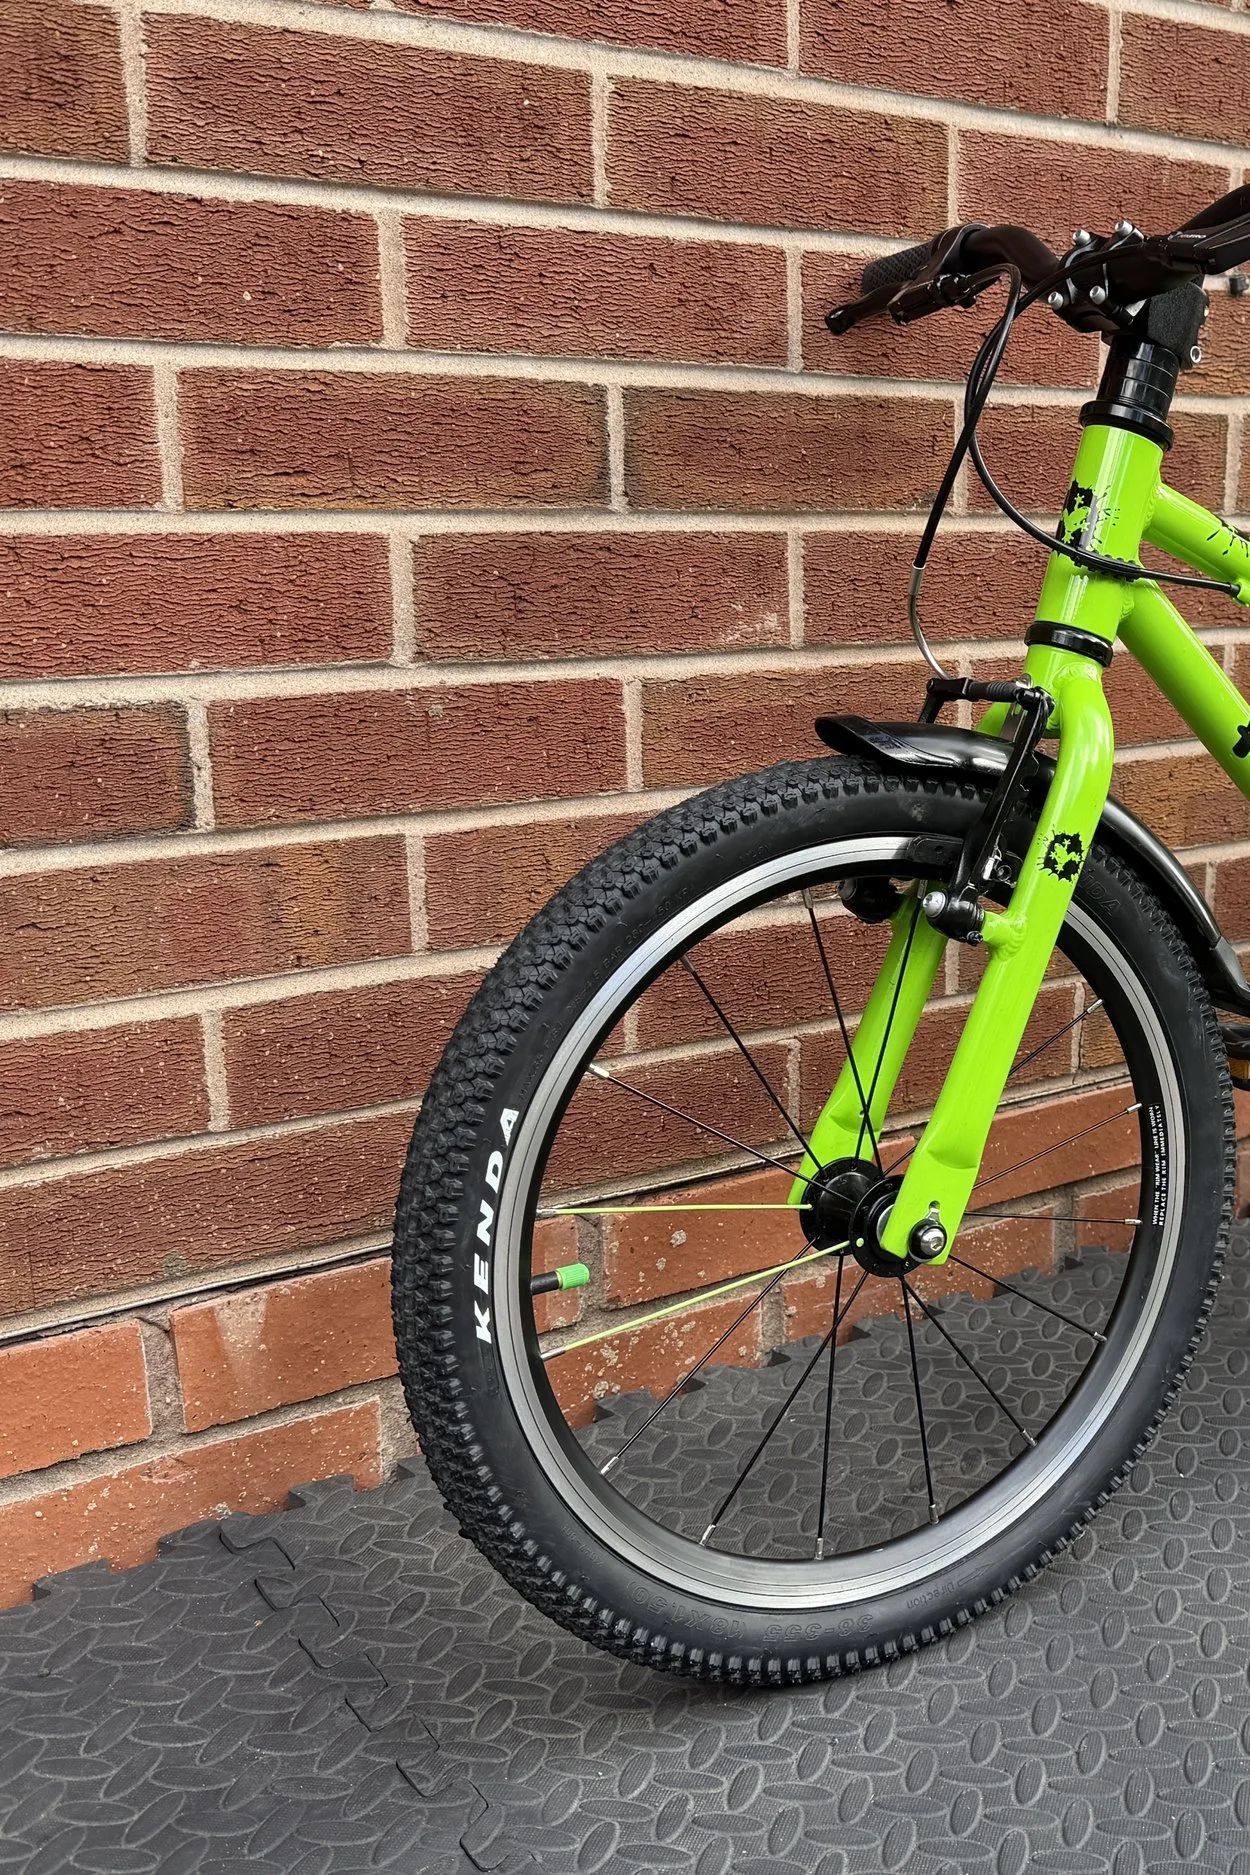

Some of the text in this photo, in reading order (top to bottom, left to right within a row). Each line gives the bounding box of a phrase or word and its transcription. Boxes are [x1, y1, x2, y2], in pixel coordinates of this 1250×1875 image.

[1154, 1104, 1166, 1156] IMMEDIATELY
[473, 1107, 520, 1345] KENDA
[1158, 1192, 1166, 1226] REPLACE
